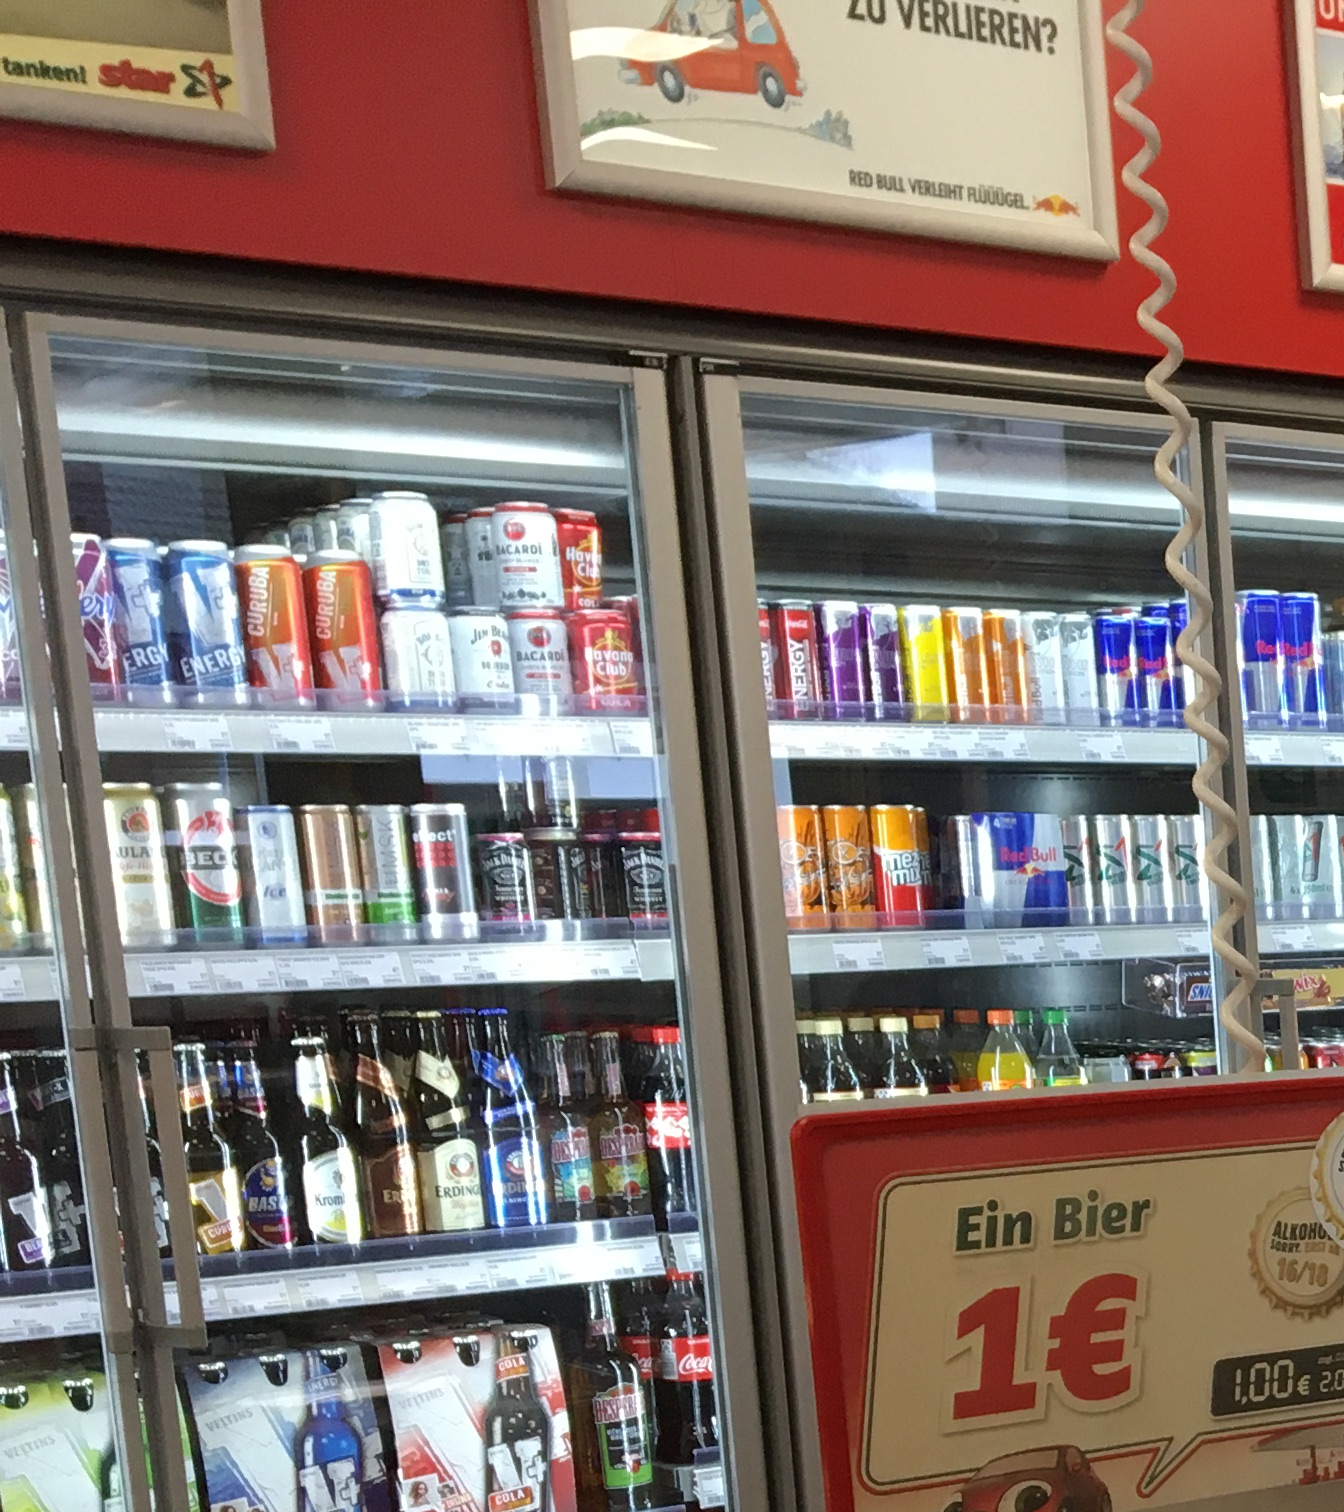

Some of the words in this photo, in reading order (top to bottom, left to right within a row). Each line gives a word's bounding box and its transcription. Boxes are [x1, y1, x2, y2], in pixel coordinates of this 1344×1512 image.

[847, 0, 886, 25] ZU
[896, 0, 1058, 55] VERLIEREN?
[98, 60, 175, 94] star
[848, 169, 873, 189] RED
[876, 173, 904, 194] BULL
[908, 178, 963, 202] VERLEIHT
[246, 567, 270, 637] CURUBA
[315, 571, 336, 640] CURUBA
[596, 662, 626, 676] Club
[1031, 847, 1056, 862] Bull
[953, 1199, 1034, 1252] Ein
[1052, 1193, 1151, 1240] Bier
[1277, 1257, 1329, 1288] 16/18
[951, 1270, 1140, 1421] 1€
[498, 1355, 527, 1373] COLA
[495, 1489, 526, 1506] COLA
